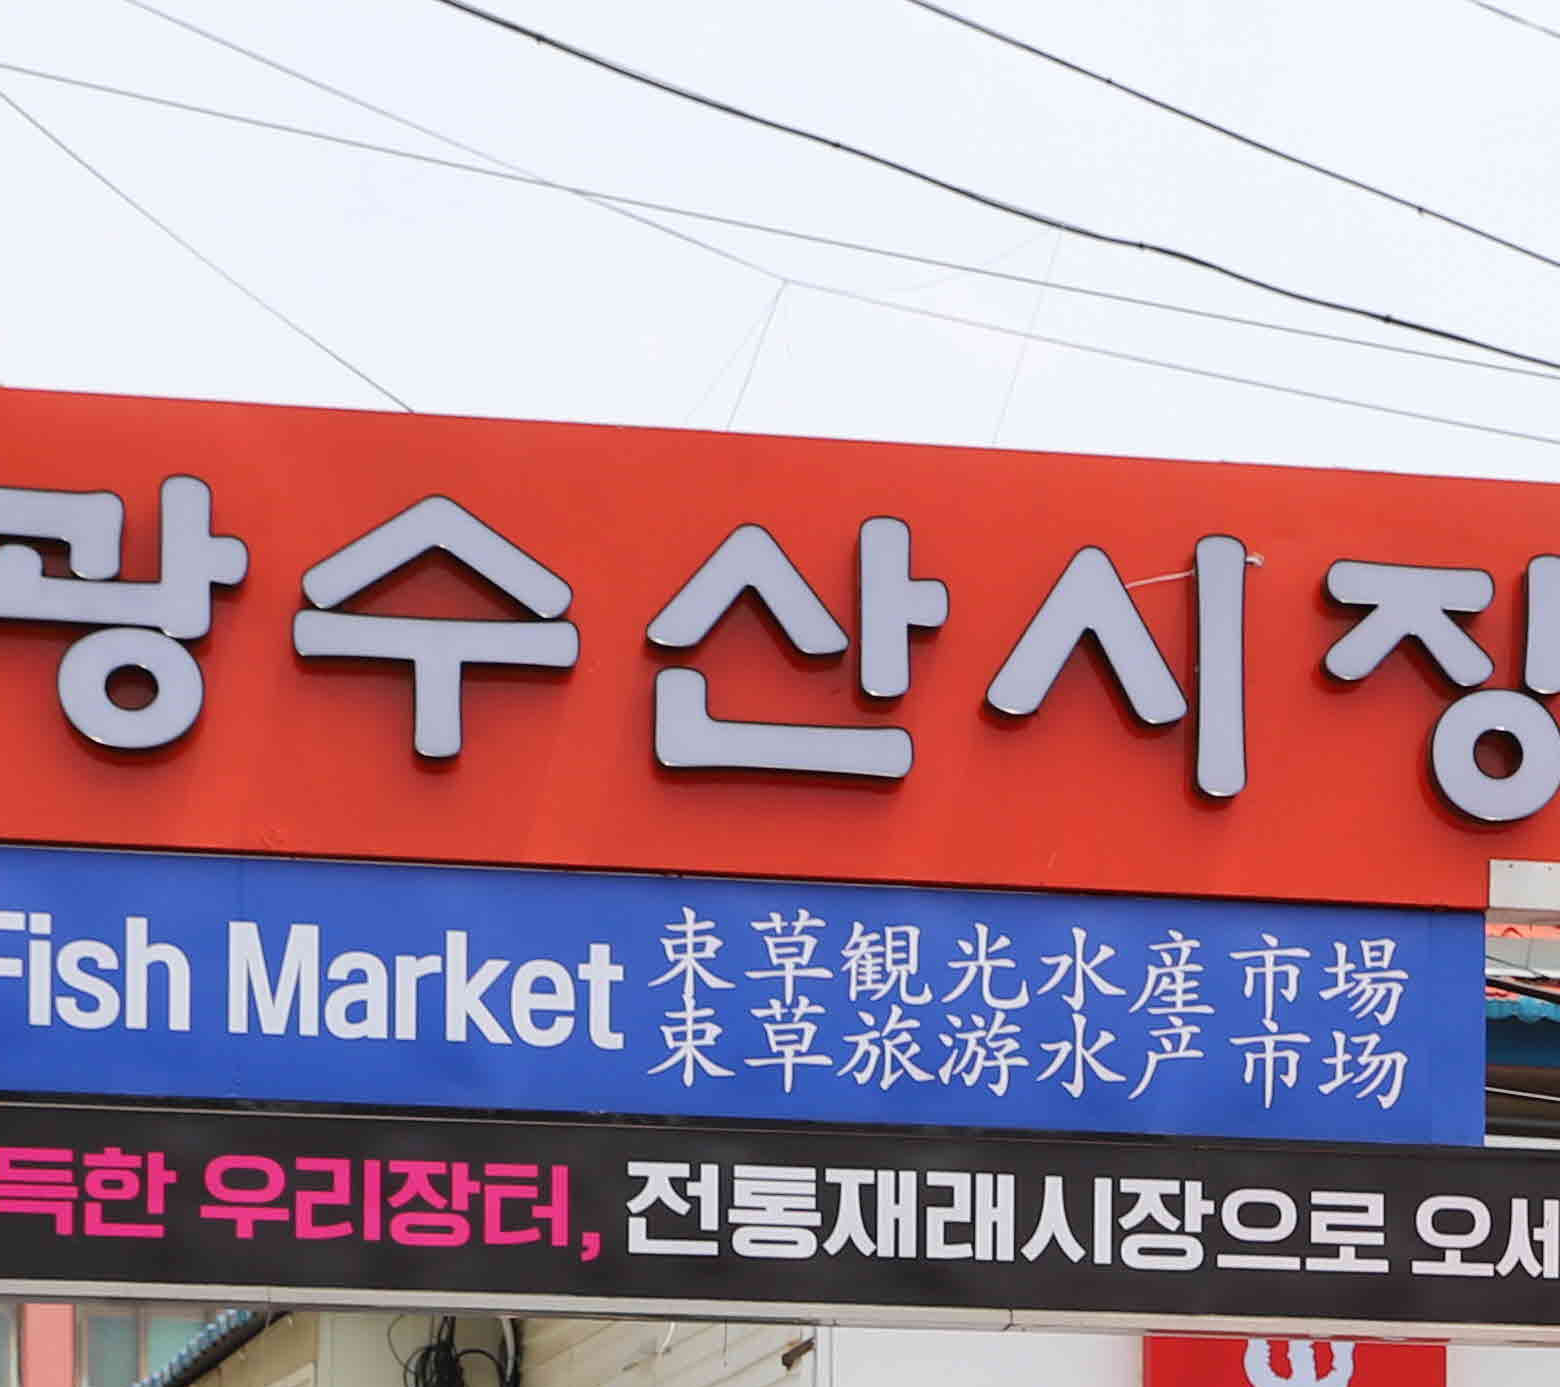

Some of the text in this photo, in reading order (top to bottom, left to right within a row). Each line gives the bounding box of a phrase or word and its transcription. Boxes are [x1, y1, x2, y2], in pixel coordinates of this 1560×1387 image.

[224, 923, 624, 1053] Market
[198, 1148, 603, 1264] 우리장터,
[624, 1156, 1388, 1275] 전통재래시장으로
